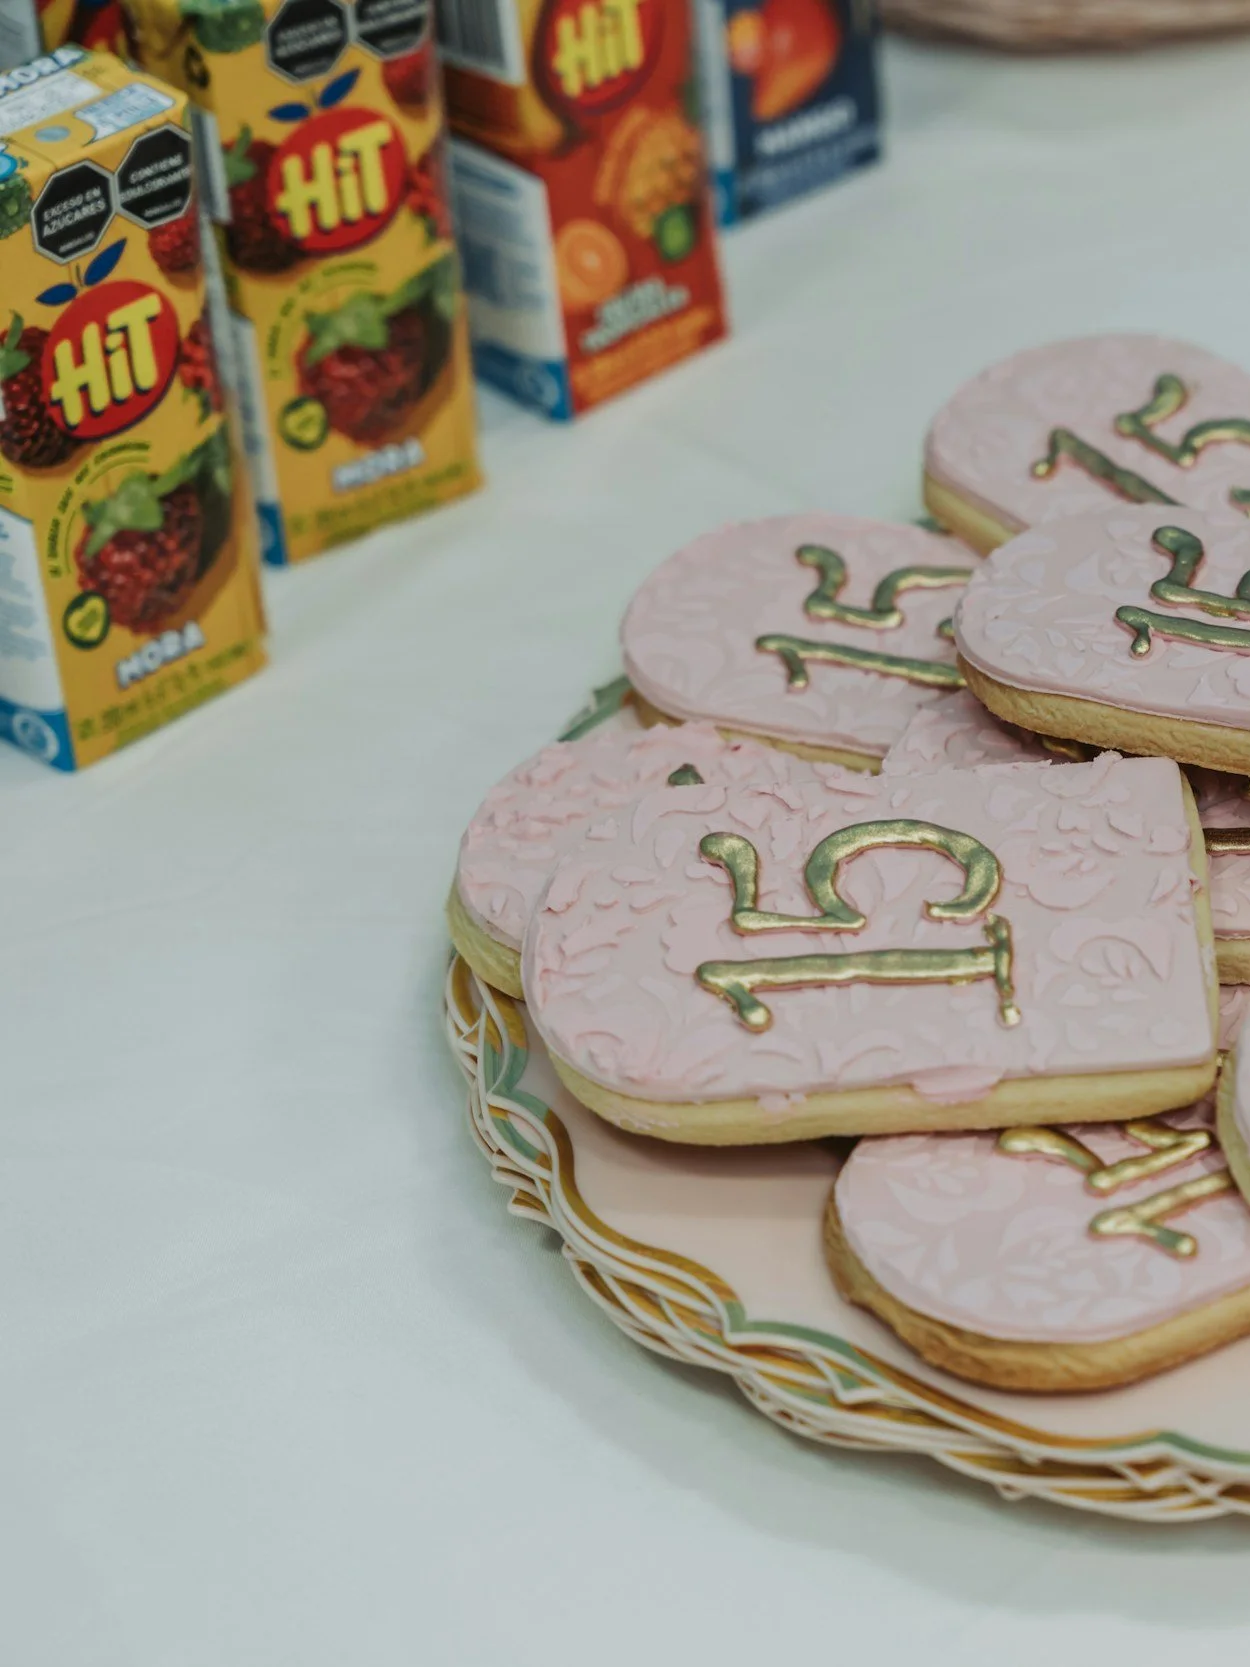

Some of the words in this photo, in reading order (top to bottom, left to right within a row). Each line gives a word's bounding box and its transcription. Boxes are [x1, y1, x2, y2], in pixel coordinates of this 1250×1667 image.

[553, 0, 643, 97] HiT
[42, 198, 106, 237] AZUCARES
[43, 193, 84, 221] EXCESO
[85, 186, 102, 202] EN
[276, 120, 393, 238] HiT
[51, 292, 162, 427] HiT
[116, 620, 206, 690] MORA
[695, 819, 1021, 1033] 15
